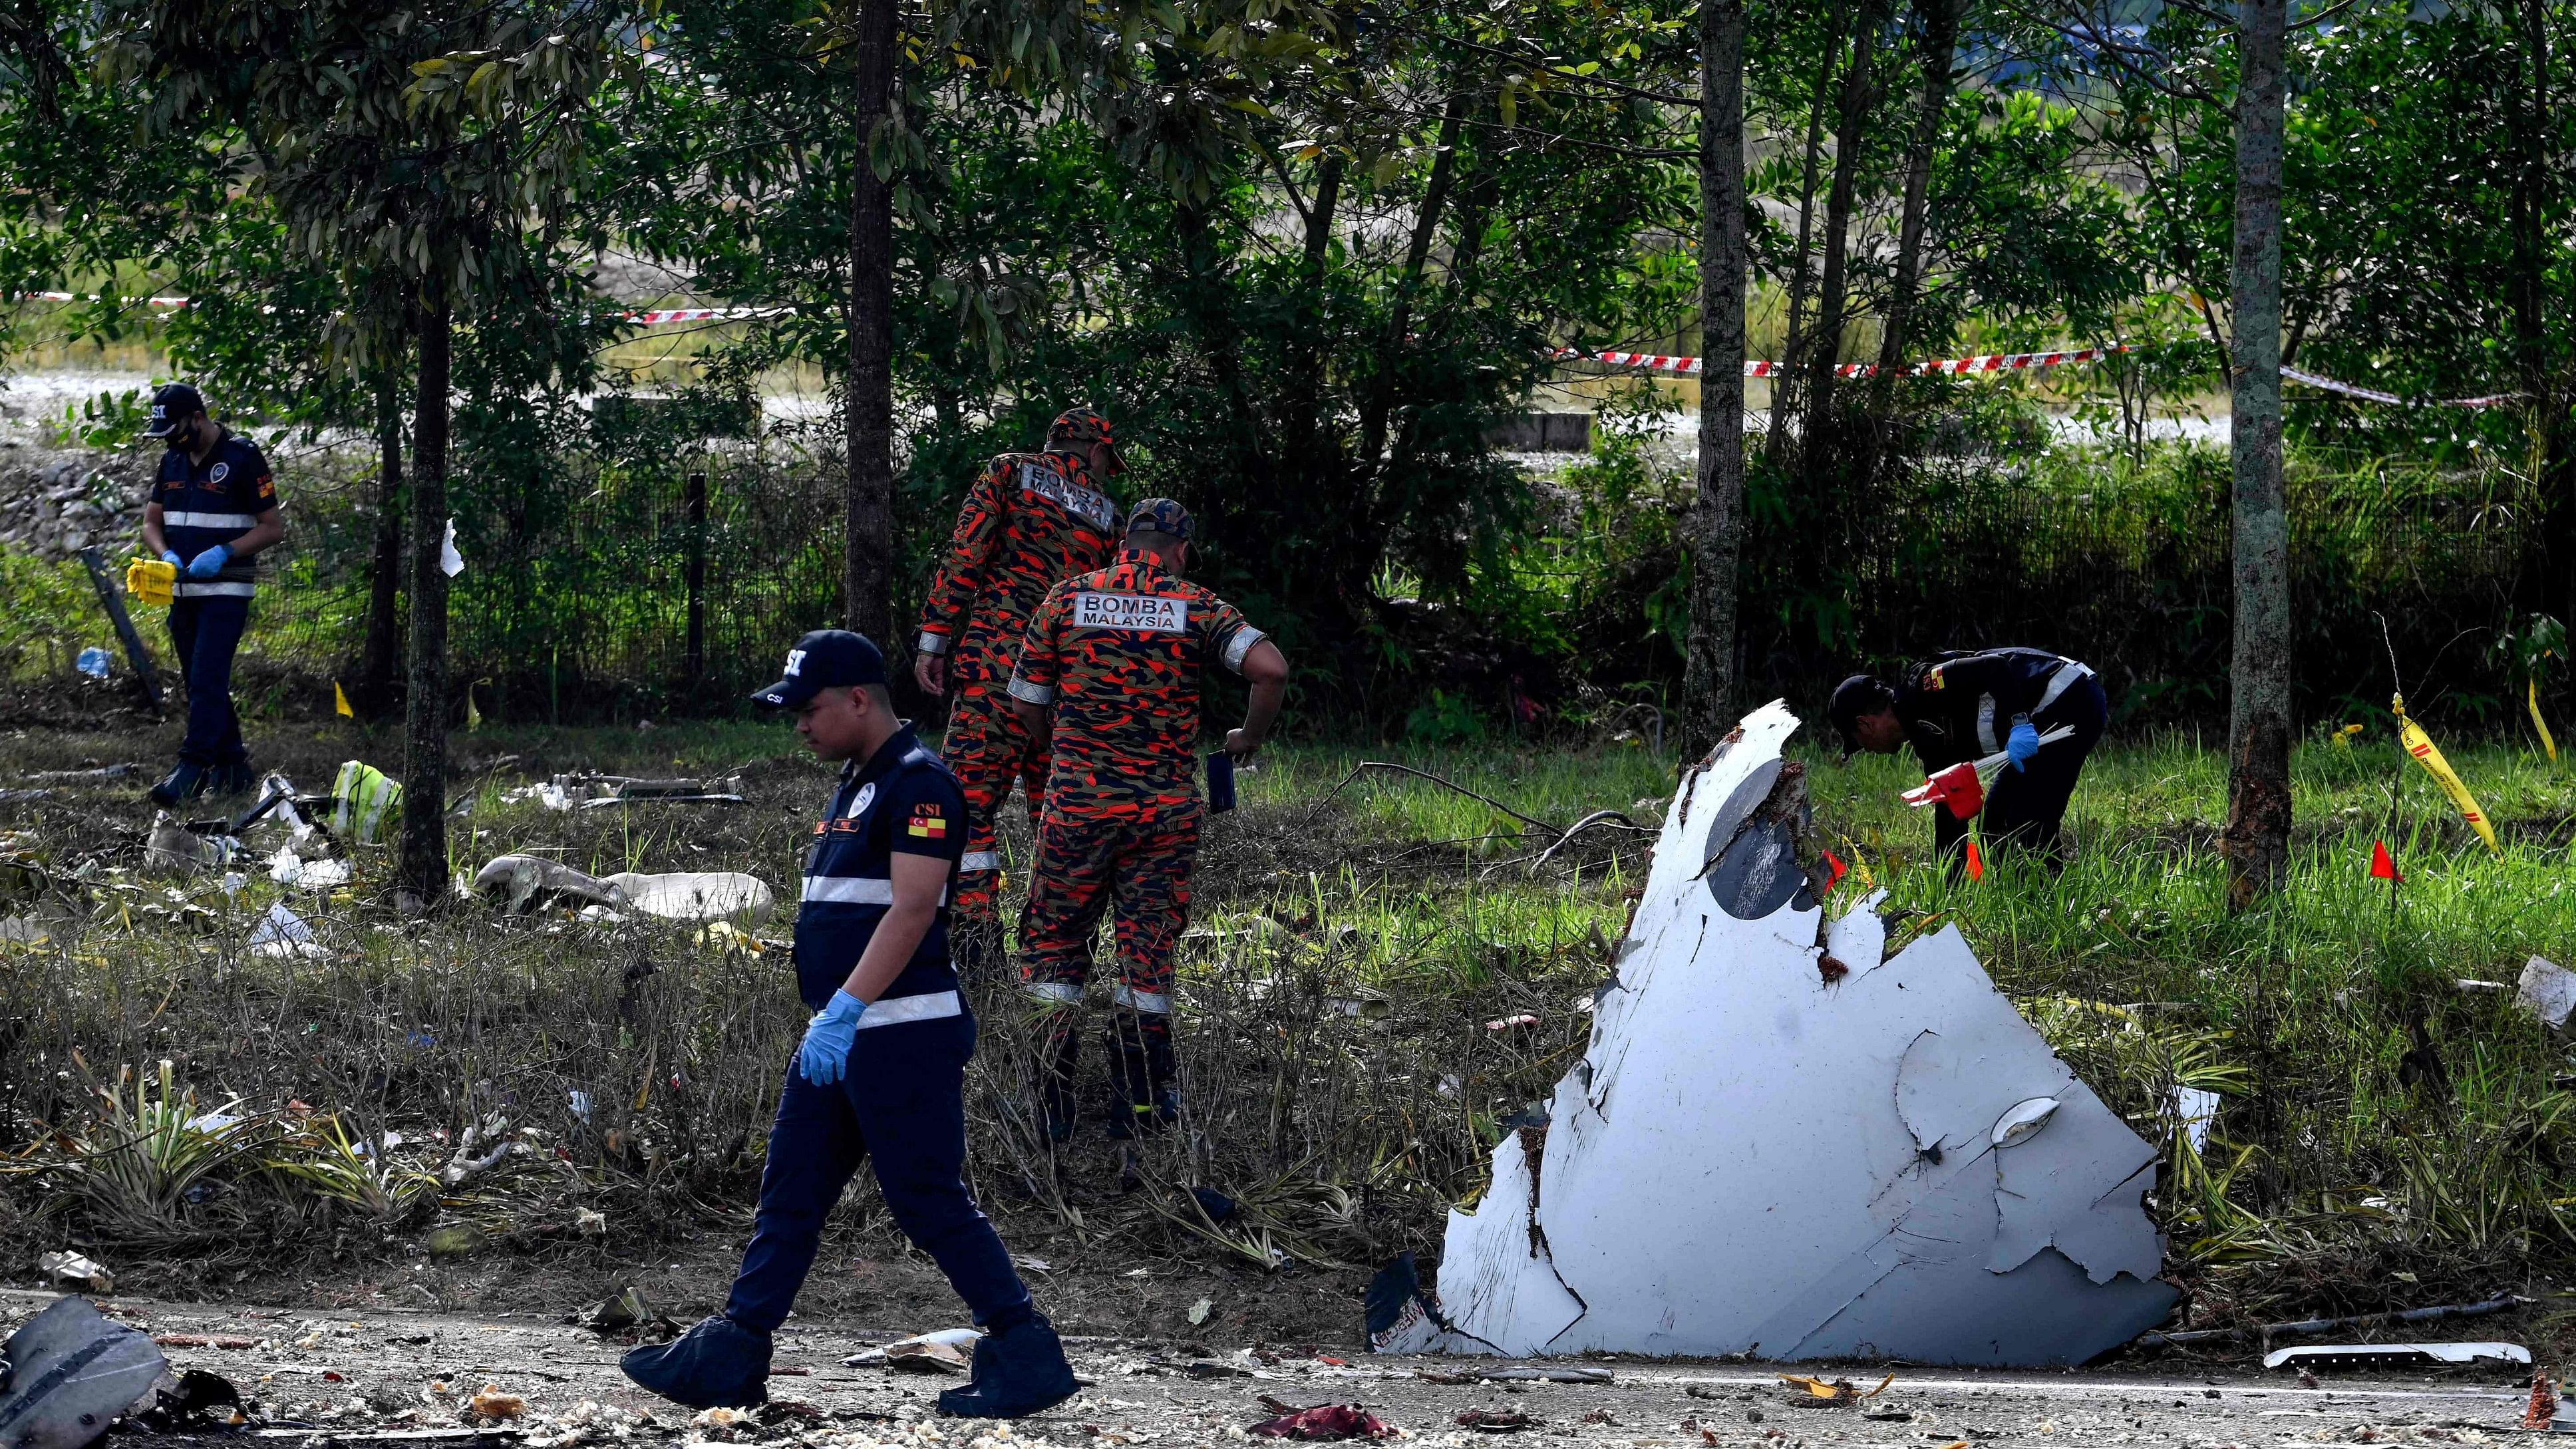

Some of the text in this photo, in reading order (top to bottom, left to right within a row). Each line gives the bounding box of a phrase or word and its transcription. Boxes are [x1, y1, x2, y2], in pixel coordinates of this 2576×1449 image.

[152, 404, 166, 419] SI
[1032, 466, 1104, 512] BOMBA
[1031, 478, 1102, 522] MALAYSIA
[1084, 595, 1175, 616] BOMBA
[1083, 612, 1175, 629] MALAYSIA
[767, 693, 783, 704] CSI
[915, 803, 940, 816] CSI
